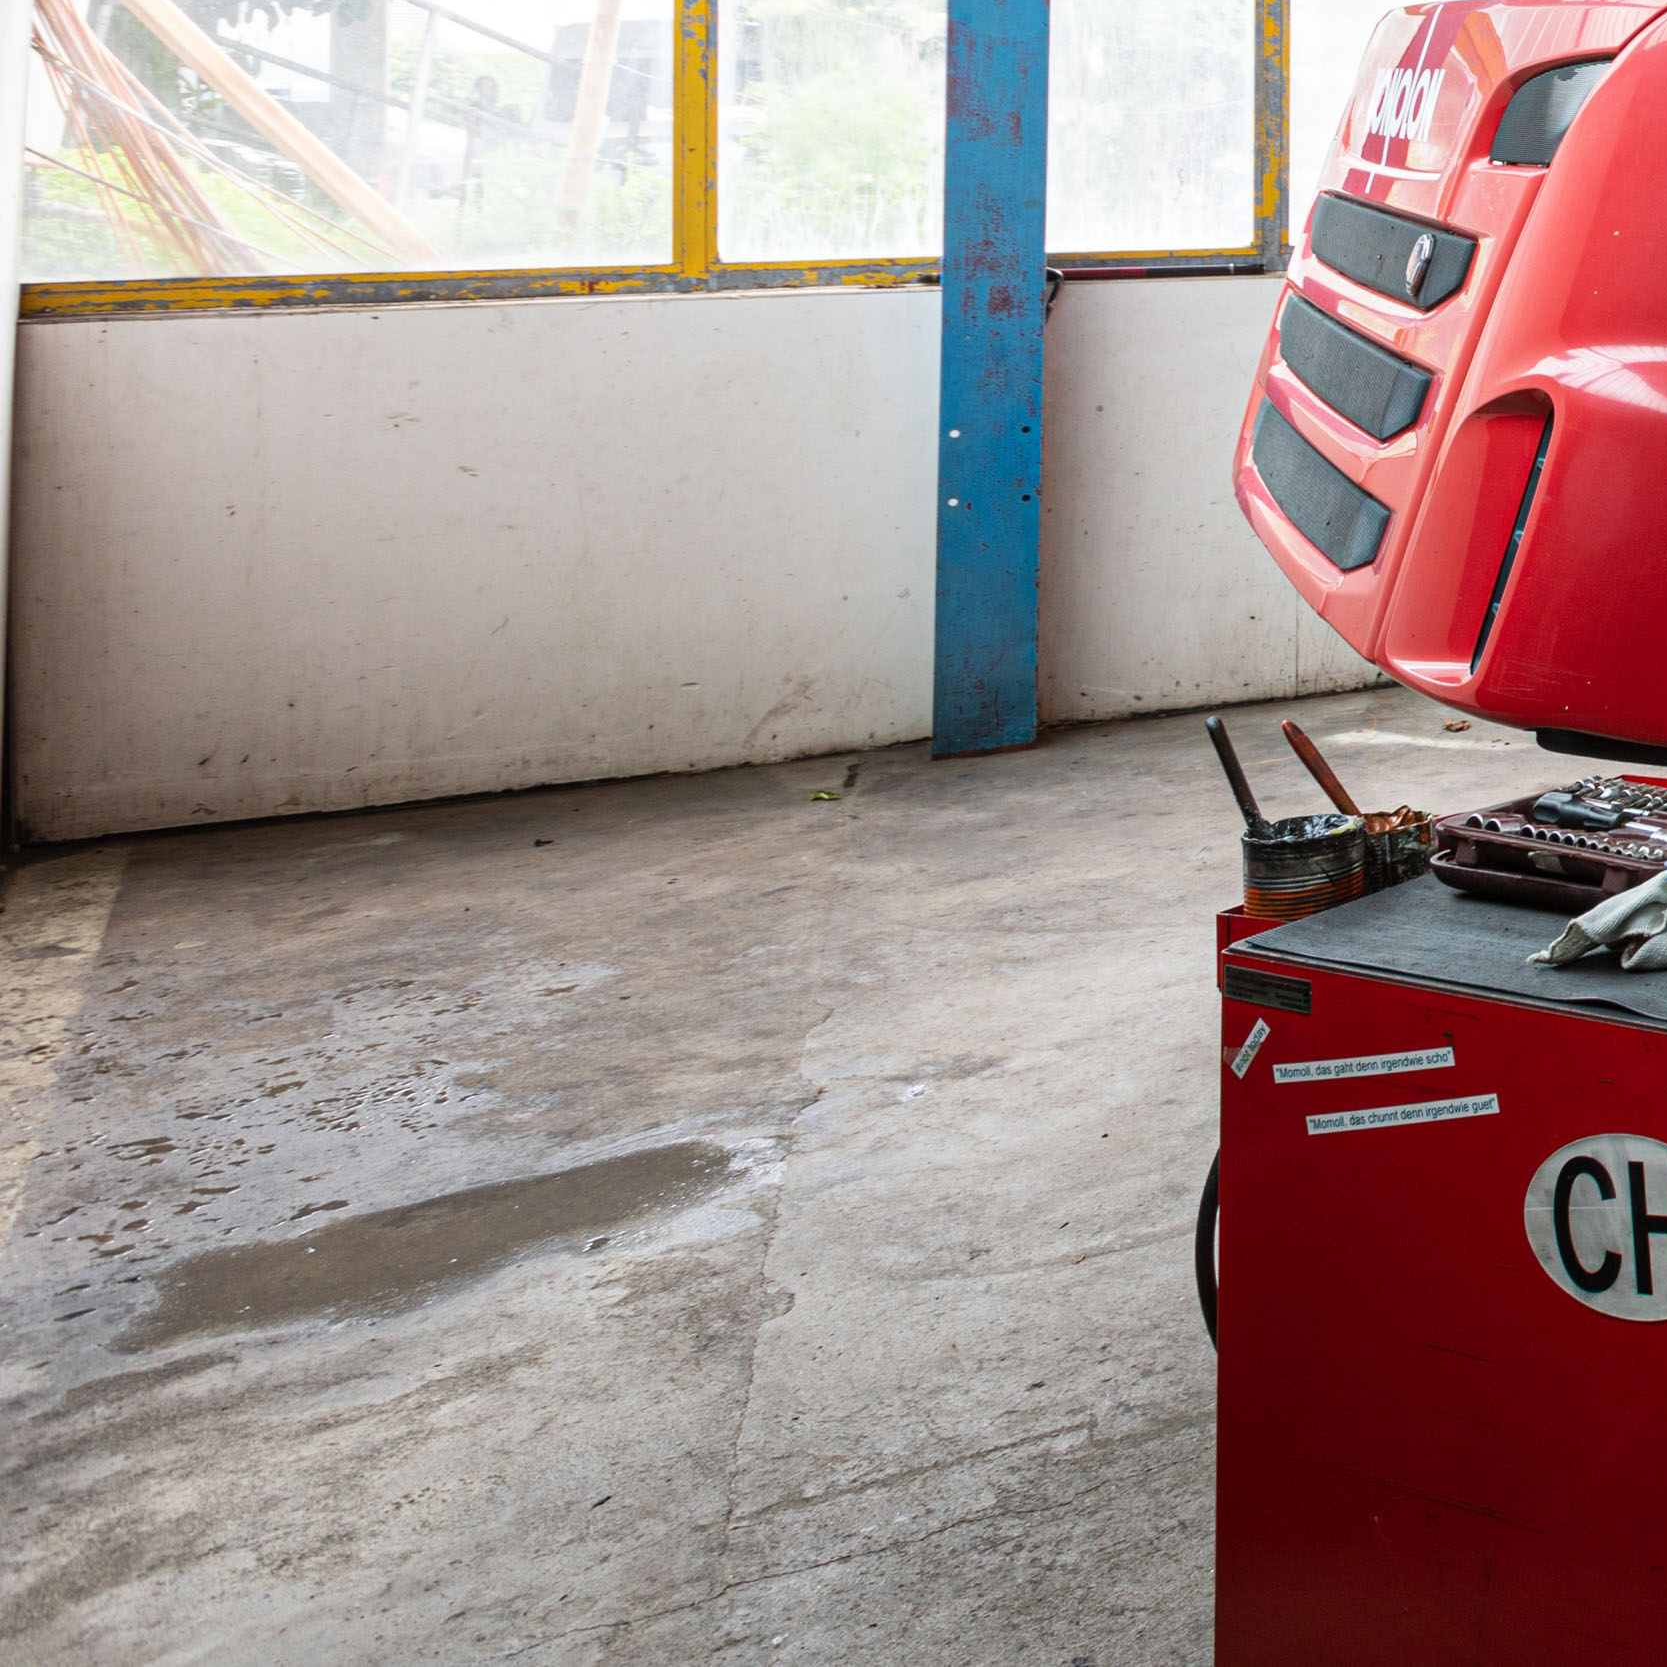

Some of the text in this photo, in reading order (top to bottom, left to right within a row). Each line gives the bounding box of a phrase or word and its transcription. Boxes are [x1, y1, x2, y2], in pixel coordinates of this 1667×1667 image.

[1247, 1023, 1267, 1052] today
[1276, 1050, 1451, 1078] "Momoll, das gaht denn irgendwie scho"
[1309, 1097, 1495, 1130] "Momoll, das chunnt denn irgendwie guet"
